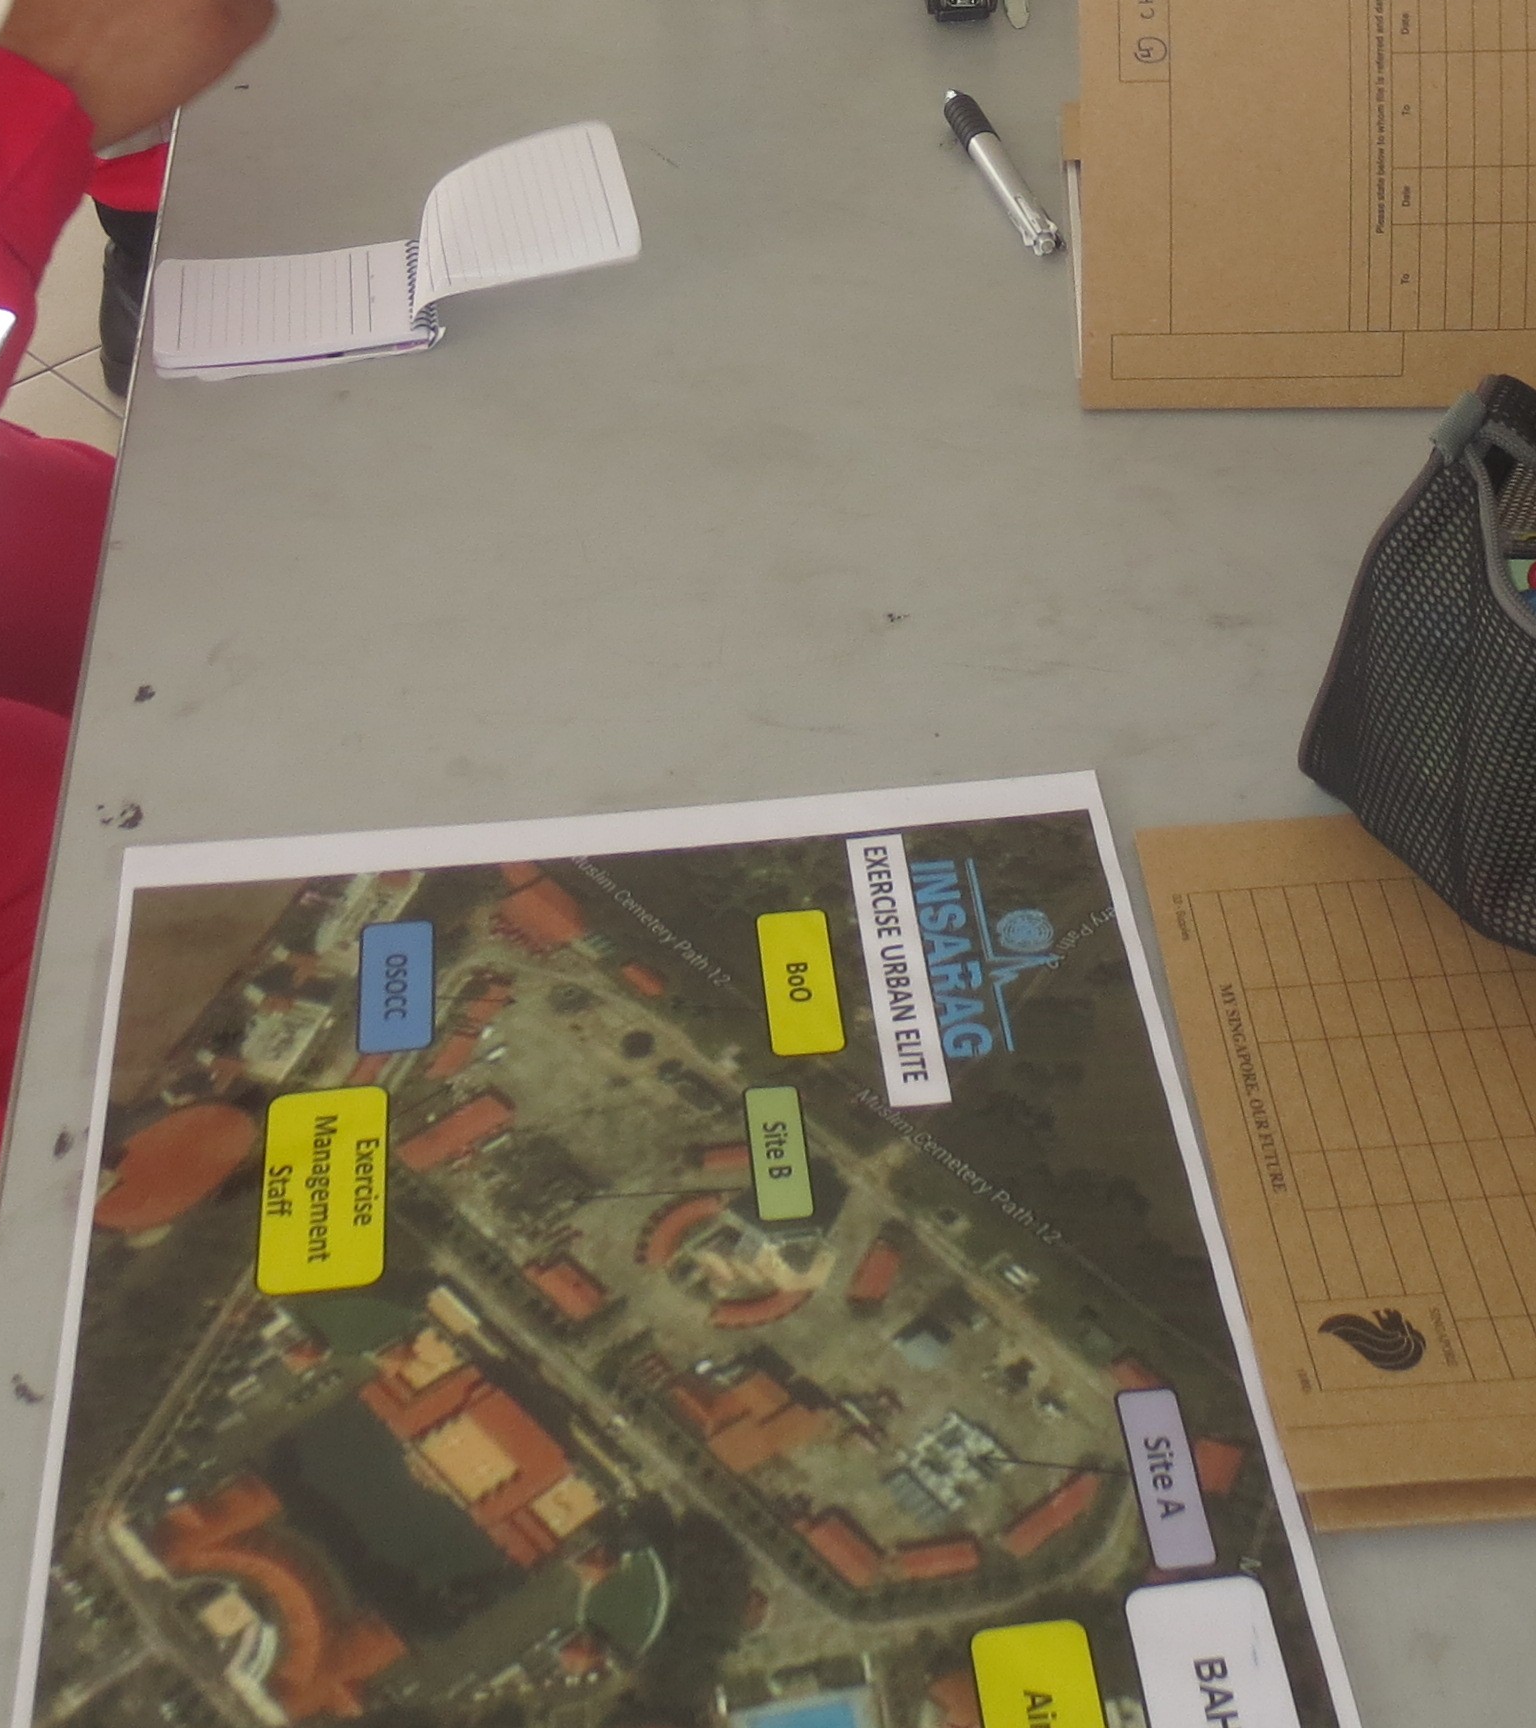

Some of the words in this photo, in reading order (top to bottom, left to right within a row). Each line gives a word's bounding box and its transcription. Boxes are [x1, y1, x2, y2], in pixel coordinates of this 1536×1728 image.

[1401, 12, 1411, 35] Date
[1402, 103, 1411, 116] To
[1402, 185, 1412, 207] Date
[1401, 272, 1410, 285] To
[864, 845, 902, 939] EXERCISE
[674, 938, 708, 971] Path
[786, 961, 813, 1003] BoO
[911, 859, 993, 1059] INSARAG
[384, 953, 408, 1021] OSOCC
[881, 948, 915, 1022] URBAN
[895, 1027, 929, 1084] ELITE
[1220, 983, 1237, 1004] MY
[1250, 1098, 1269, 1128] OUR
[1260, 1132, 1287, 1192] FUTURE
[763, 1121, 784, 1160] Site
[267, 1164, 293, 1217] Staff
[307, 1114, 338, 1264] Management
[353, 1137, 380, 1227] Exercise
[768, 1165, 793, 1179] B
[912, 1132, 991, 1195] Cemetery
[991, 1190, 1034, 1232] Path
[1143, 1435, 1173, 1493] Site
[1157, 1498, 1186, 1520] A
